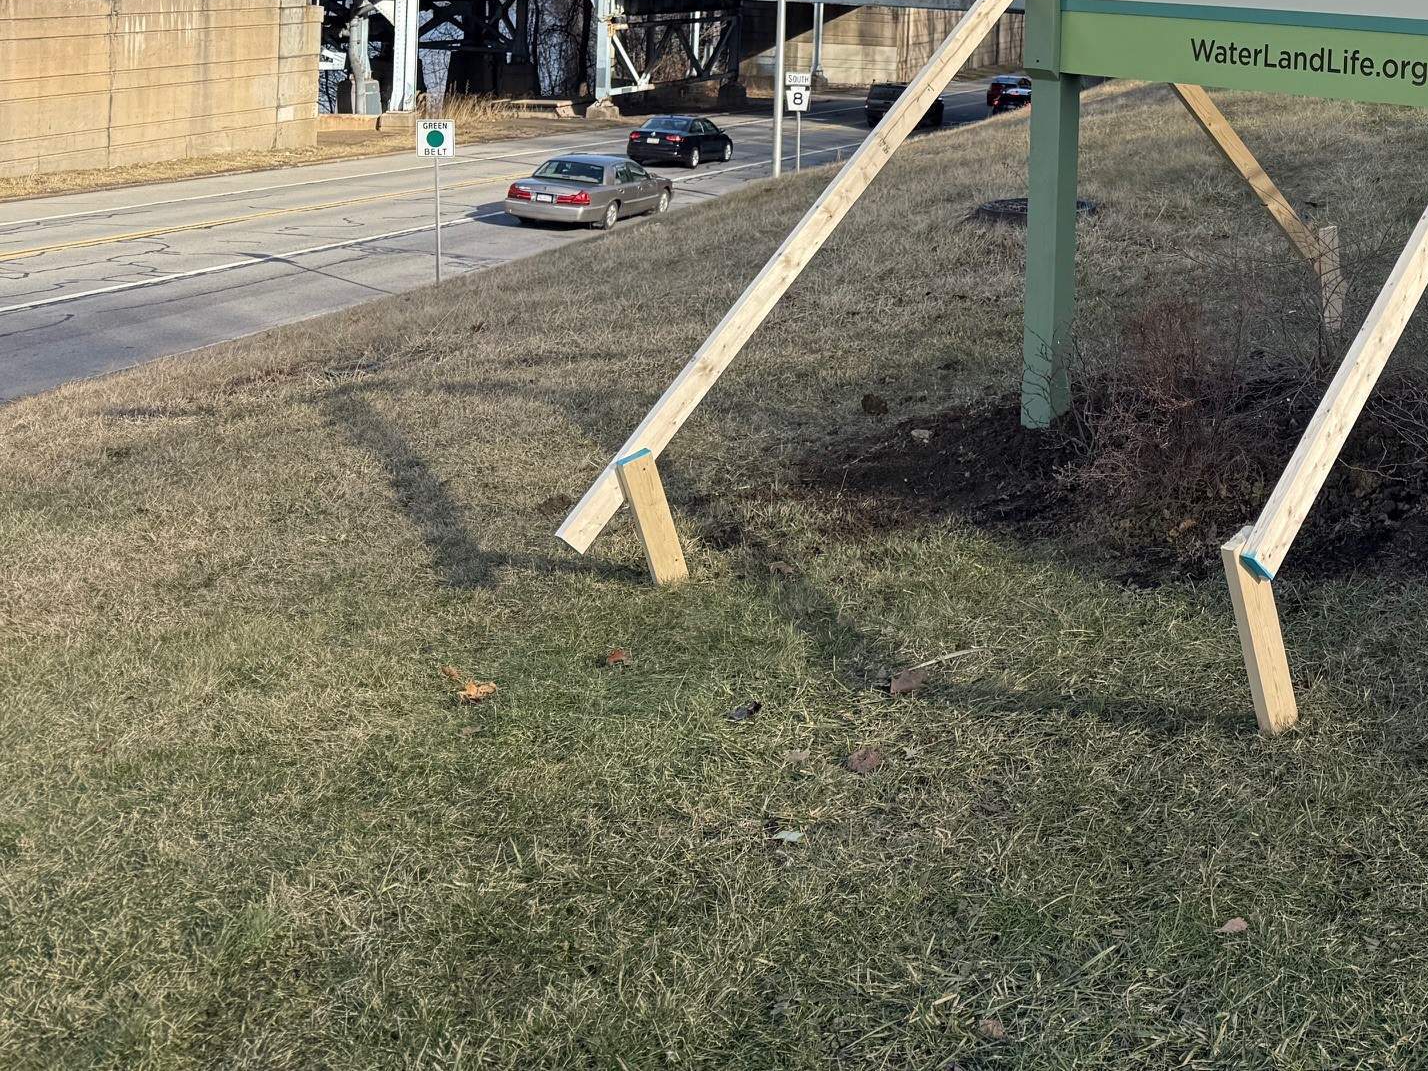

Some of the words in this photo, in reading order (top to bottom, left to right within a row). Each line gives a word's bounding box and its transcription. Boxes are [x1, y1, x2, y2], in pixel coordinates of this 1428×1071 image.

[1190, 37, 1428, 87] WaterLandLife.org
[788, 74, 810, 84] SOUTH
[793, 92, 804, 106] 8
[422, 122, 448, 130] GREEN
[424, 148, 448, 156] BELT
